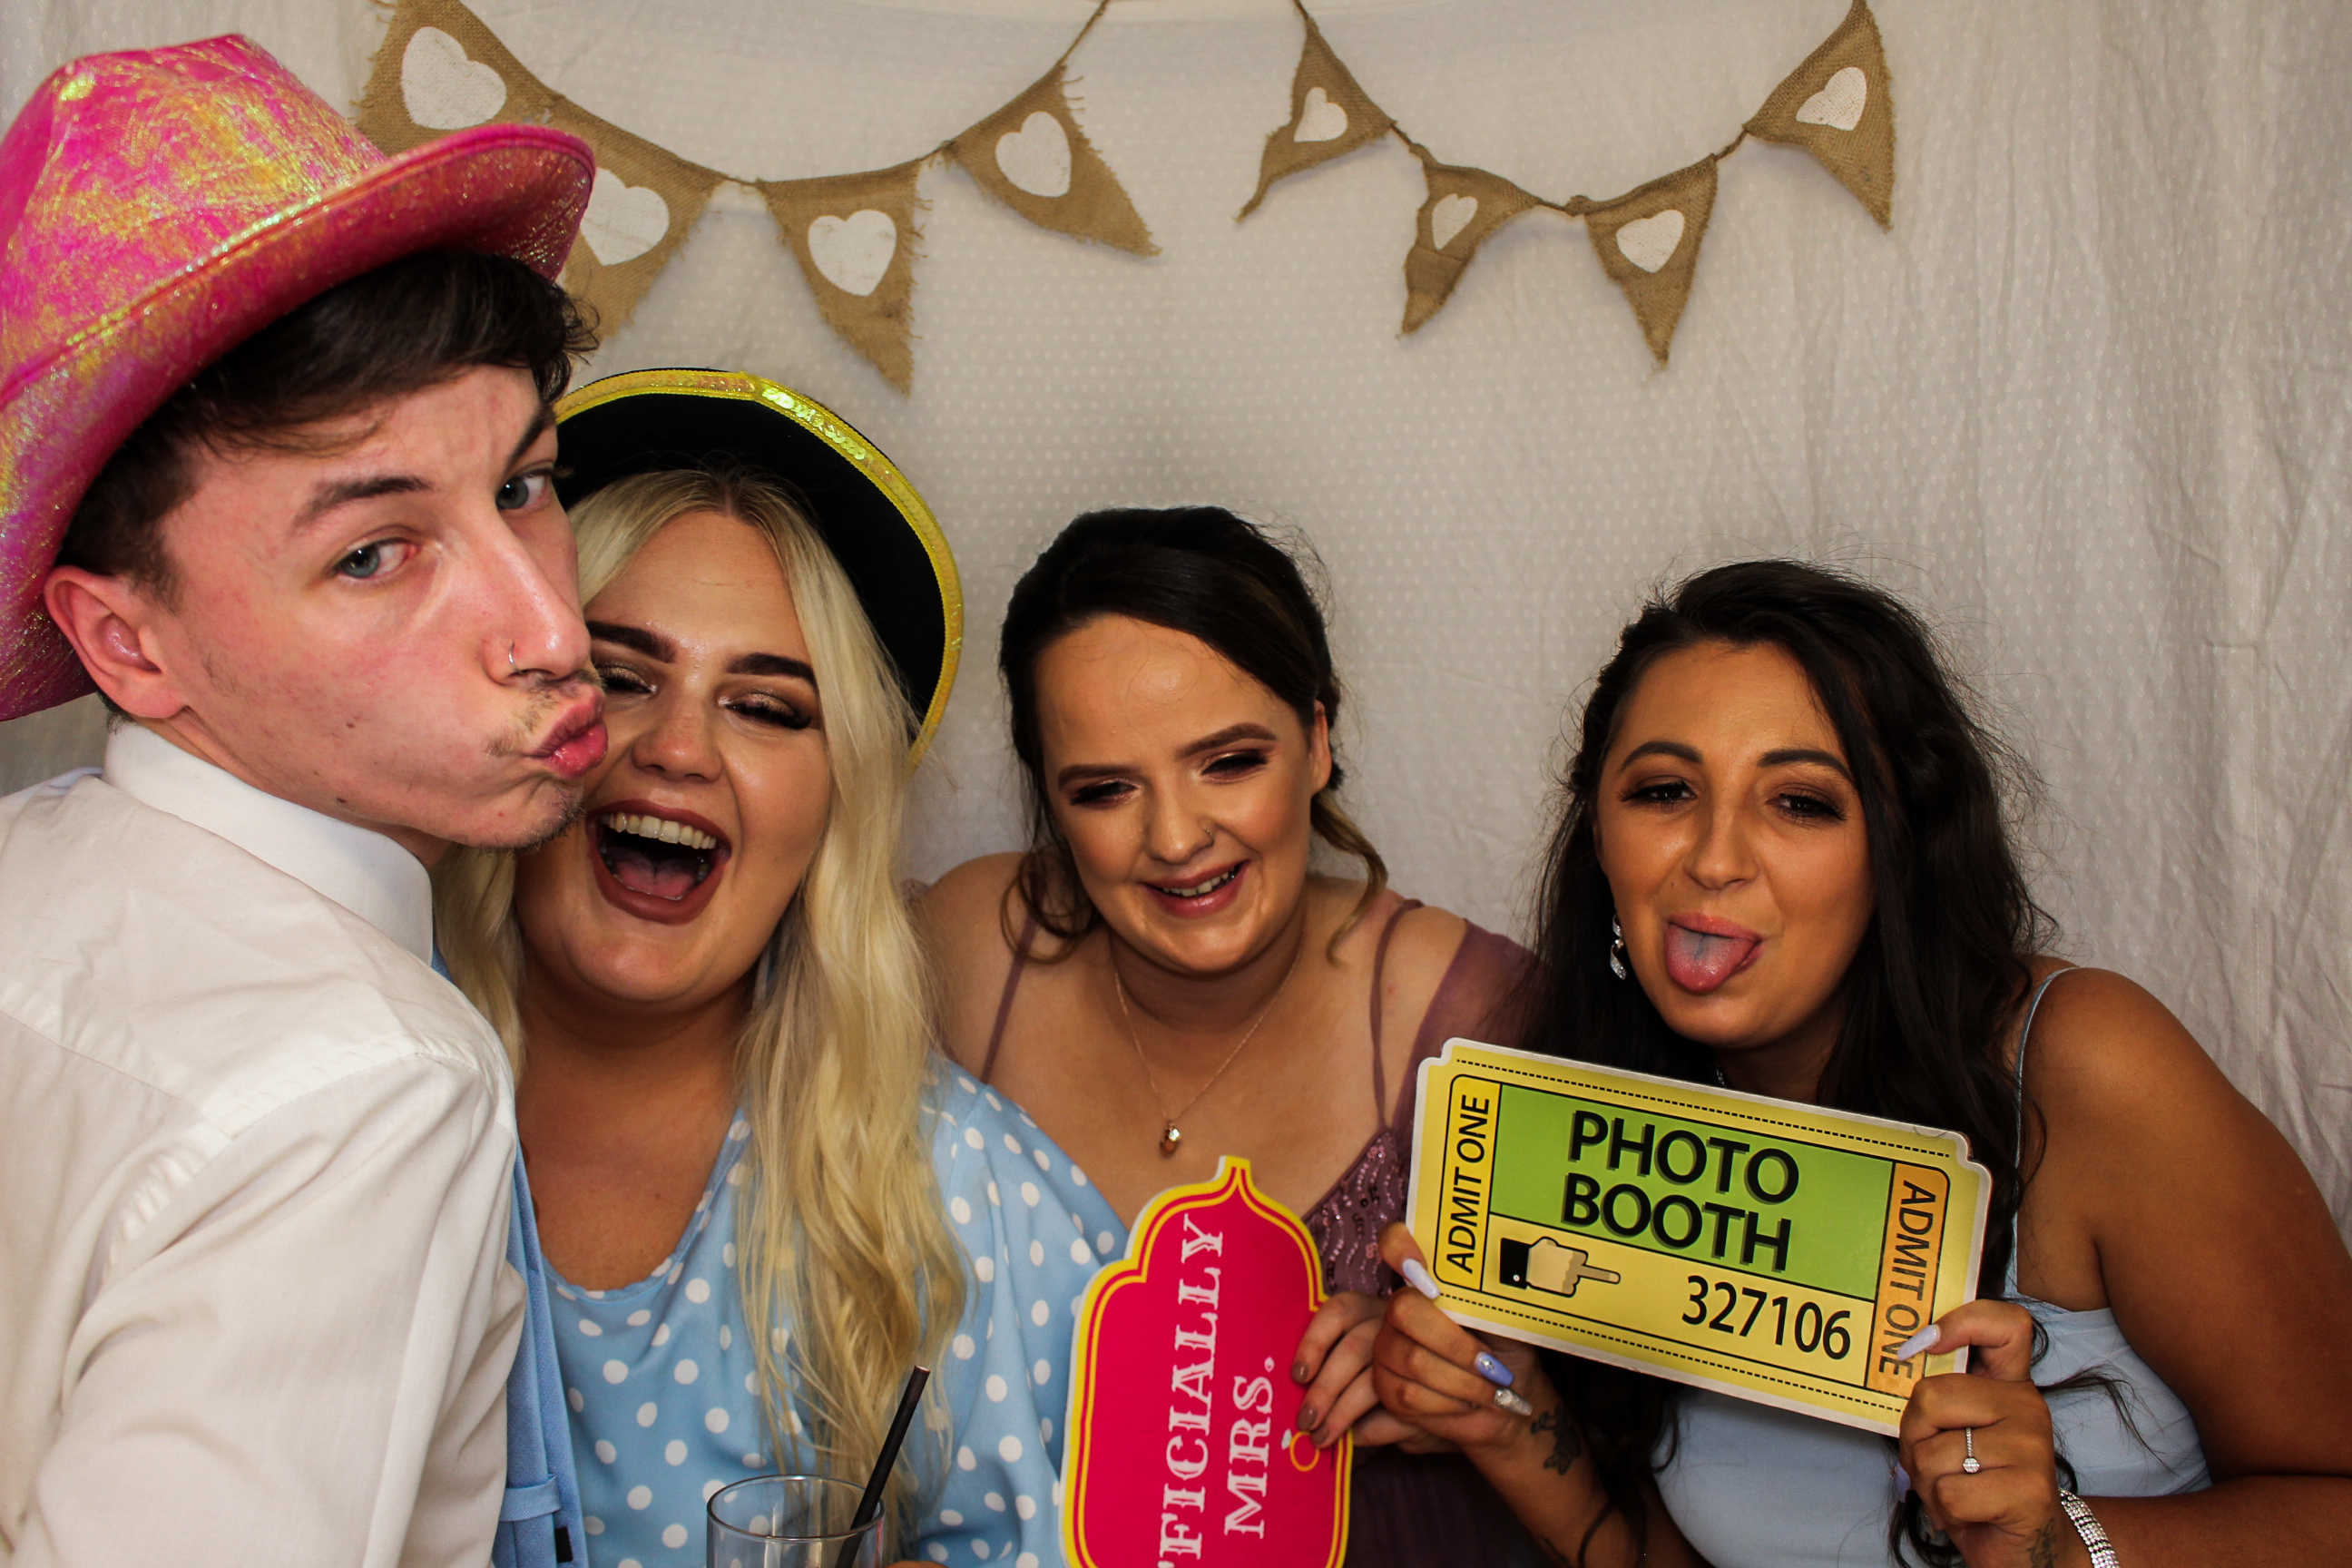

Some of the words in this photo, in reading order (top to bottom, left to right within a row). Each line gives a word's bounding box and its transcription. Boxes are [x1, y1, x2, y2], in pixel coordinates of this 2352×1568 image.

[1456, 1094, 1490, 1163] ONE
[1568, 1109, 1799, 1205] PHOTO
[1446, 1166, 1482, 1275] ADMIT
[1562, 1172, 1792, 1273] BOOTH
[1890, 1180, 1936, 1301] ADMIT
[1681, 1275, 1851, 1360] 327106
[1157, 1213, 1223, 1568] FICIALLY
[1224, 1357, 1274, 1540] MRS.
